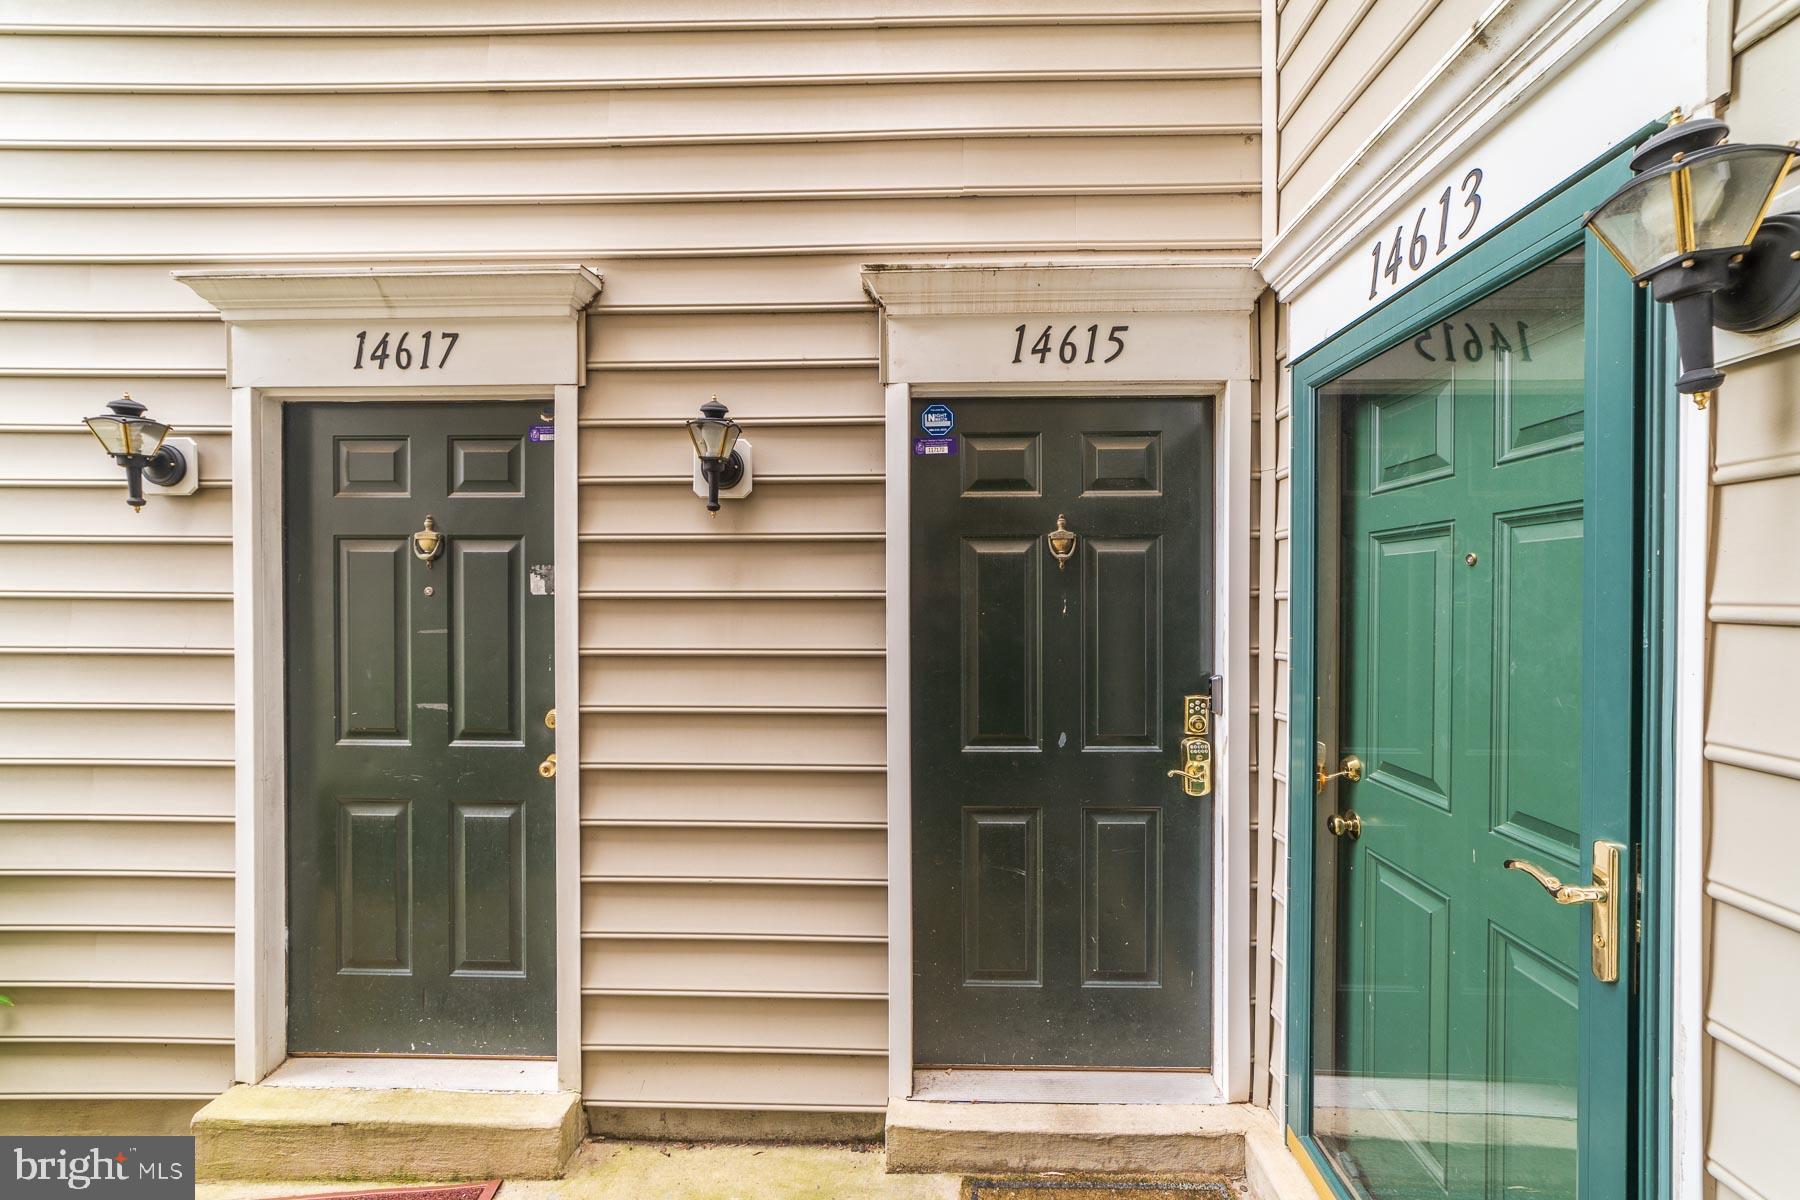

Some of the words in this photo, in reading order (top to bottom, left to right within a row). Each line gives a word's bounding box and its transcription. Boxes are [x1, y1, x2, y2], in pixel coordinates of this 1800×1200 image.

[1368, 167, 1484, 301] 14613
[353, 330, 460, 370] 14617
[1011, 323, 1129, 364] 14615
